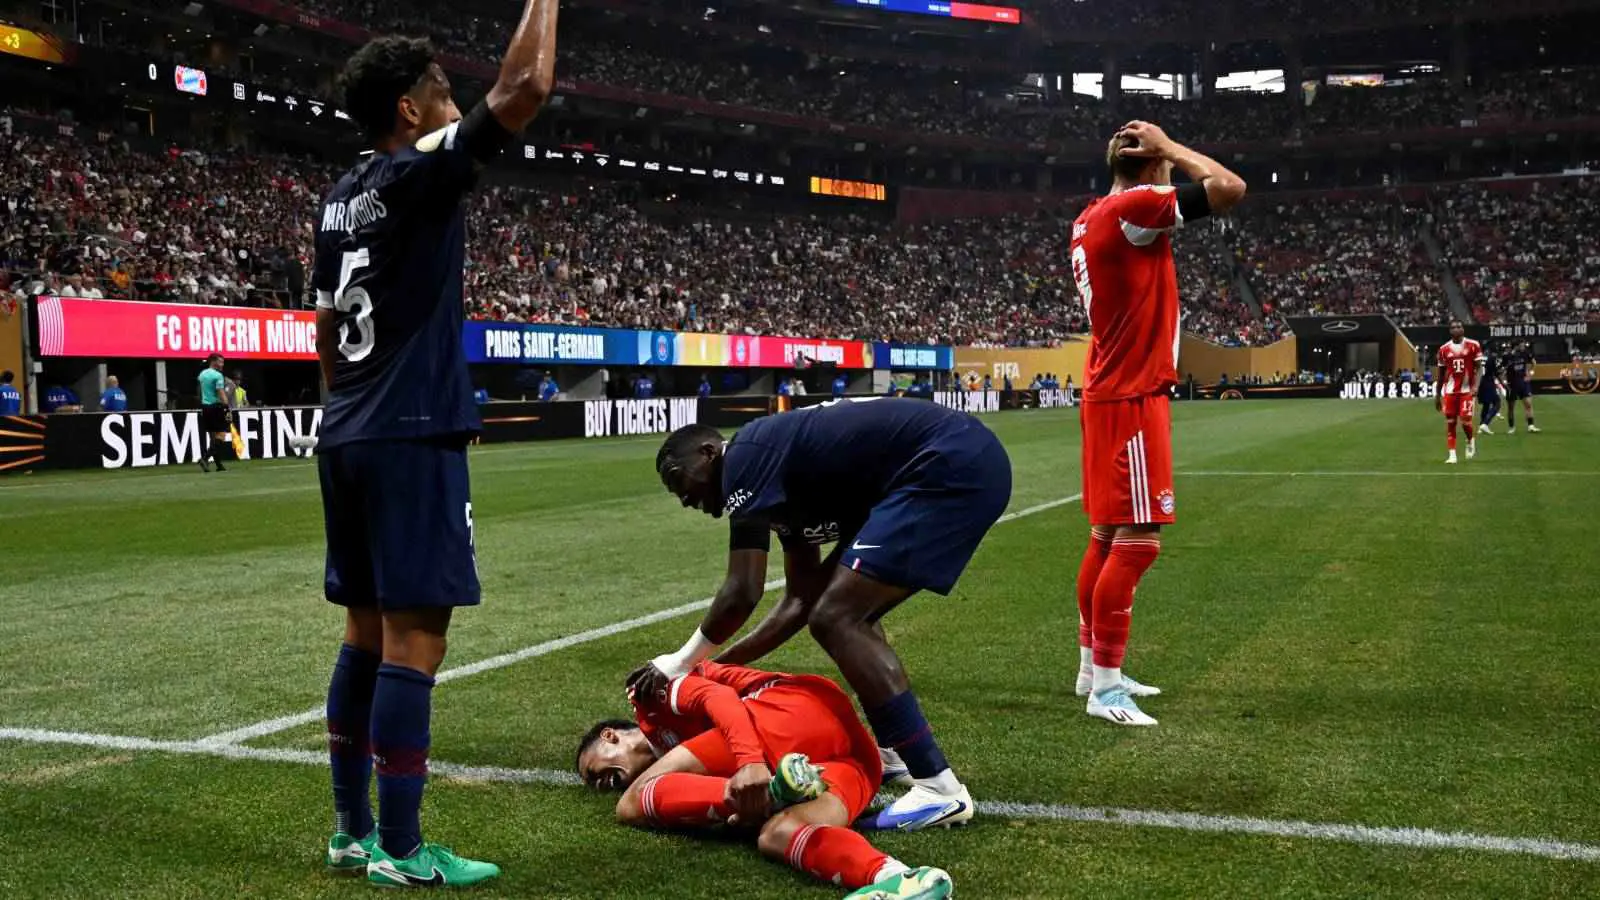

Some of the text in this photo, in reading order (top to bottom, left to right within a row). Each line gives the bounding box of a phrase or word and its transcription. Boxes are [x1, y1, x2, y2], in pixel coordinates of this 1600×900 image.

[148, 63, 157, 80] 0
[334, 247, 376, 362] 5
[155, 314, 182, 351] FC
[188, 316, 261, 353] BAYERN
[1489, 322, 1587, 337] Take It To The World
[485, 329, 604, 360] PARIS SAINT-GERMAIN
[993, 361, 1020, 379] FIFA
[1339, 382, 1372, 399] JULY
[1375, 382, 1384, 398] 8
[1388, 382, 1398, 398] &
[585, 397, 698, 438] BUY TICKETS NOW
